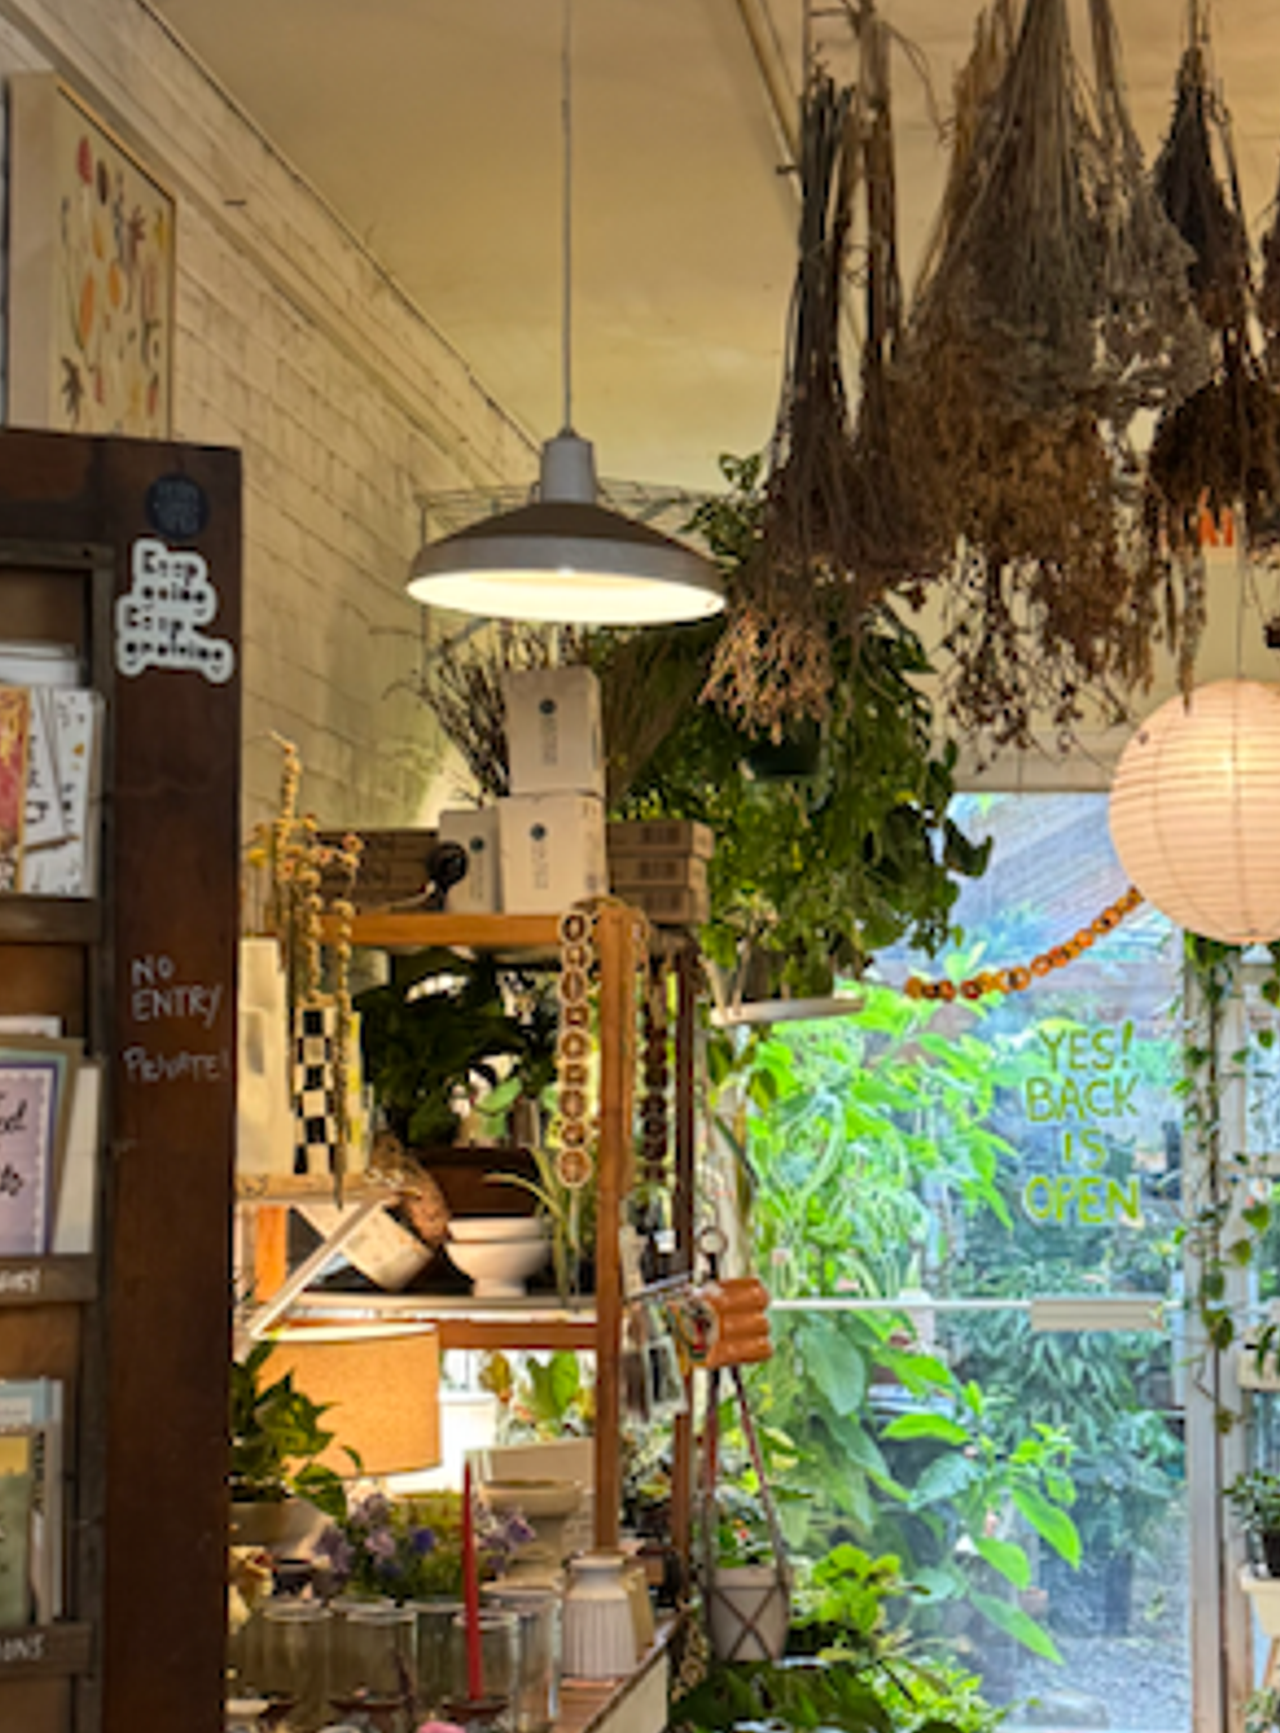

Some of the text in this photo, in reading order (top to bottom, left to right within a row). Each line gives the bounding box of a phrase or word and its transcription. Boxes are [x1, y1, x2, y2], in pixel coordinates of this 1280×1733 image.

[130, 953, 176, 987] NO
[131, 983, 223, 1029] ENTRY
[1038, 1020, 1135, 1073] YES!
[1025, 1073, 1142, 1123] BACK
[1063, 1127, 1109, 1171] IS
[1024, 1175, 1142, 1224] OPEN
